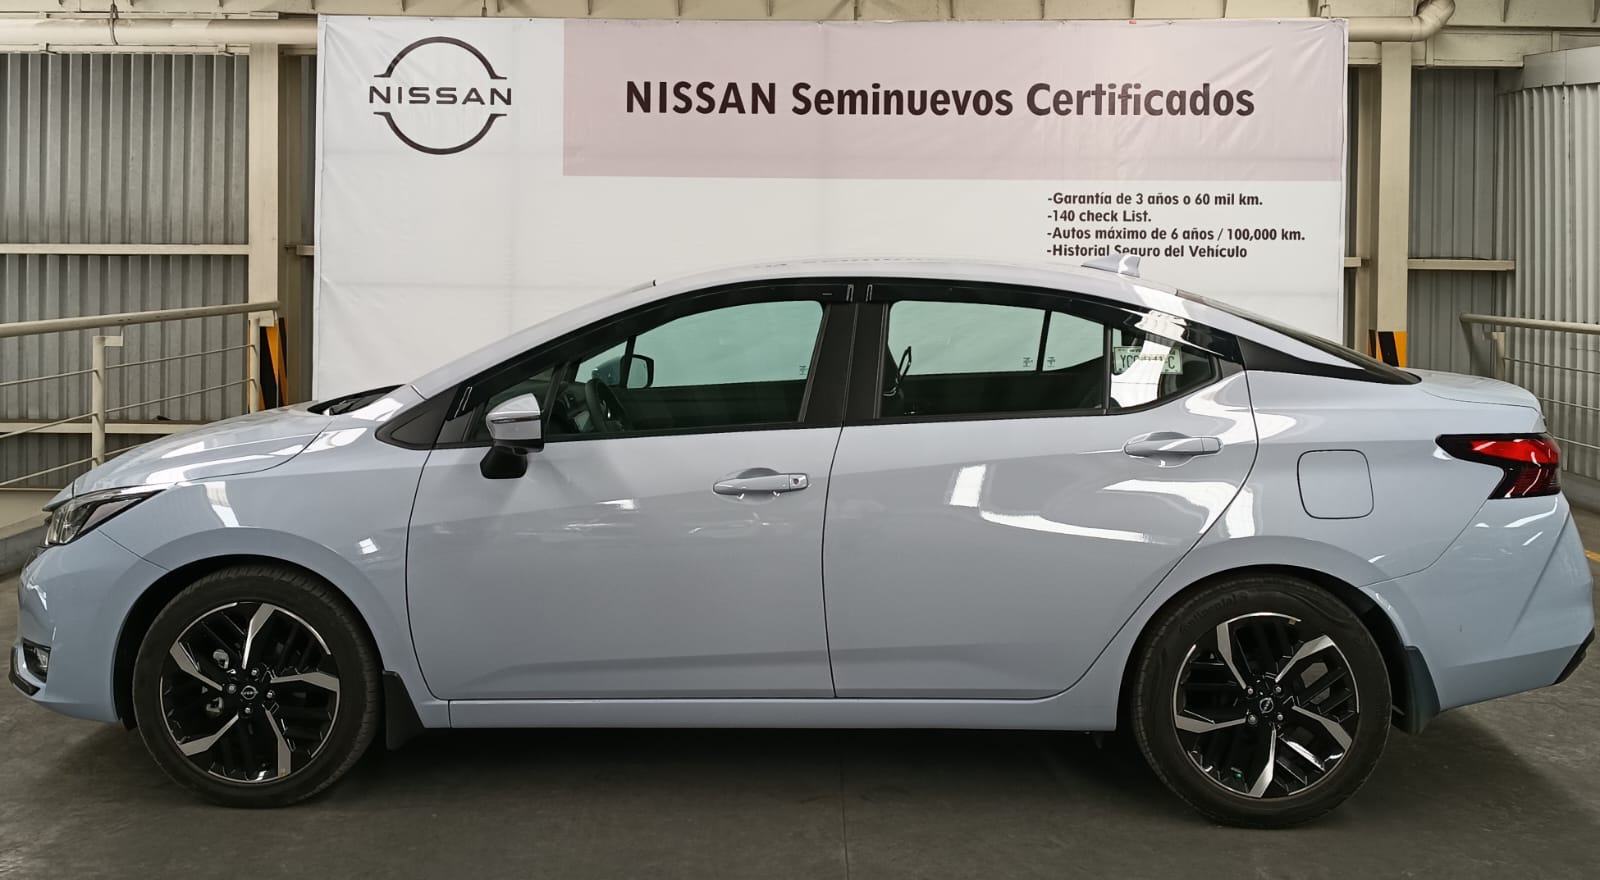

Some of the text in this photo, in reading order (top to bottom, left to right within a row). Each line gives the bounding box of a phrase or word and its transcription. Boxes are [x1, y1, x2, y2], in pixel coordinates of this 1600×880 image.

[369, 86, 512, 106] NISSAN
[626, 80, 1255, 117] NISSAN Seminuevos Certificados
[1047, 191, 1263, 206] -Garantía de 3 años o 60 mil km.
[1047, 209, 1152, 223] -140 check List.
[1047, 226, 1306, 242] -Autos máximo de 6 años / 100,000 km.
[1046, 243, 1110, 257] -Historial
[1164, 244, 1185, 258] del
[1188, 244, 1248, 258] Vehículo
